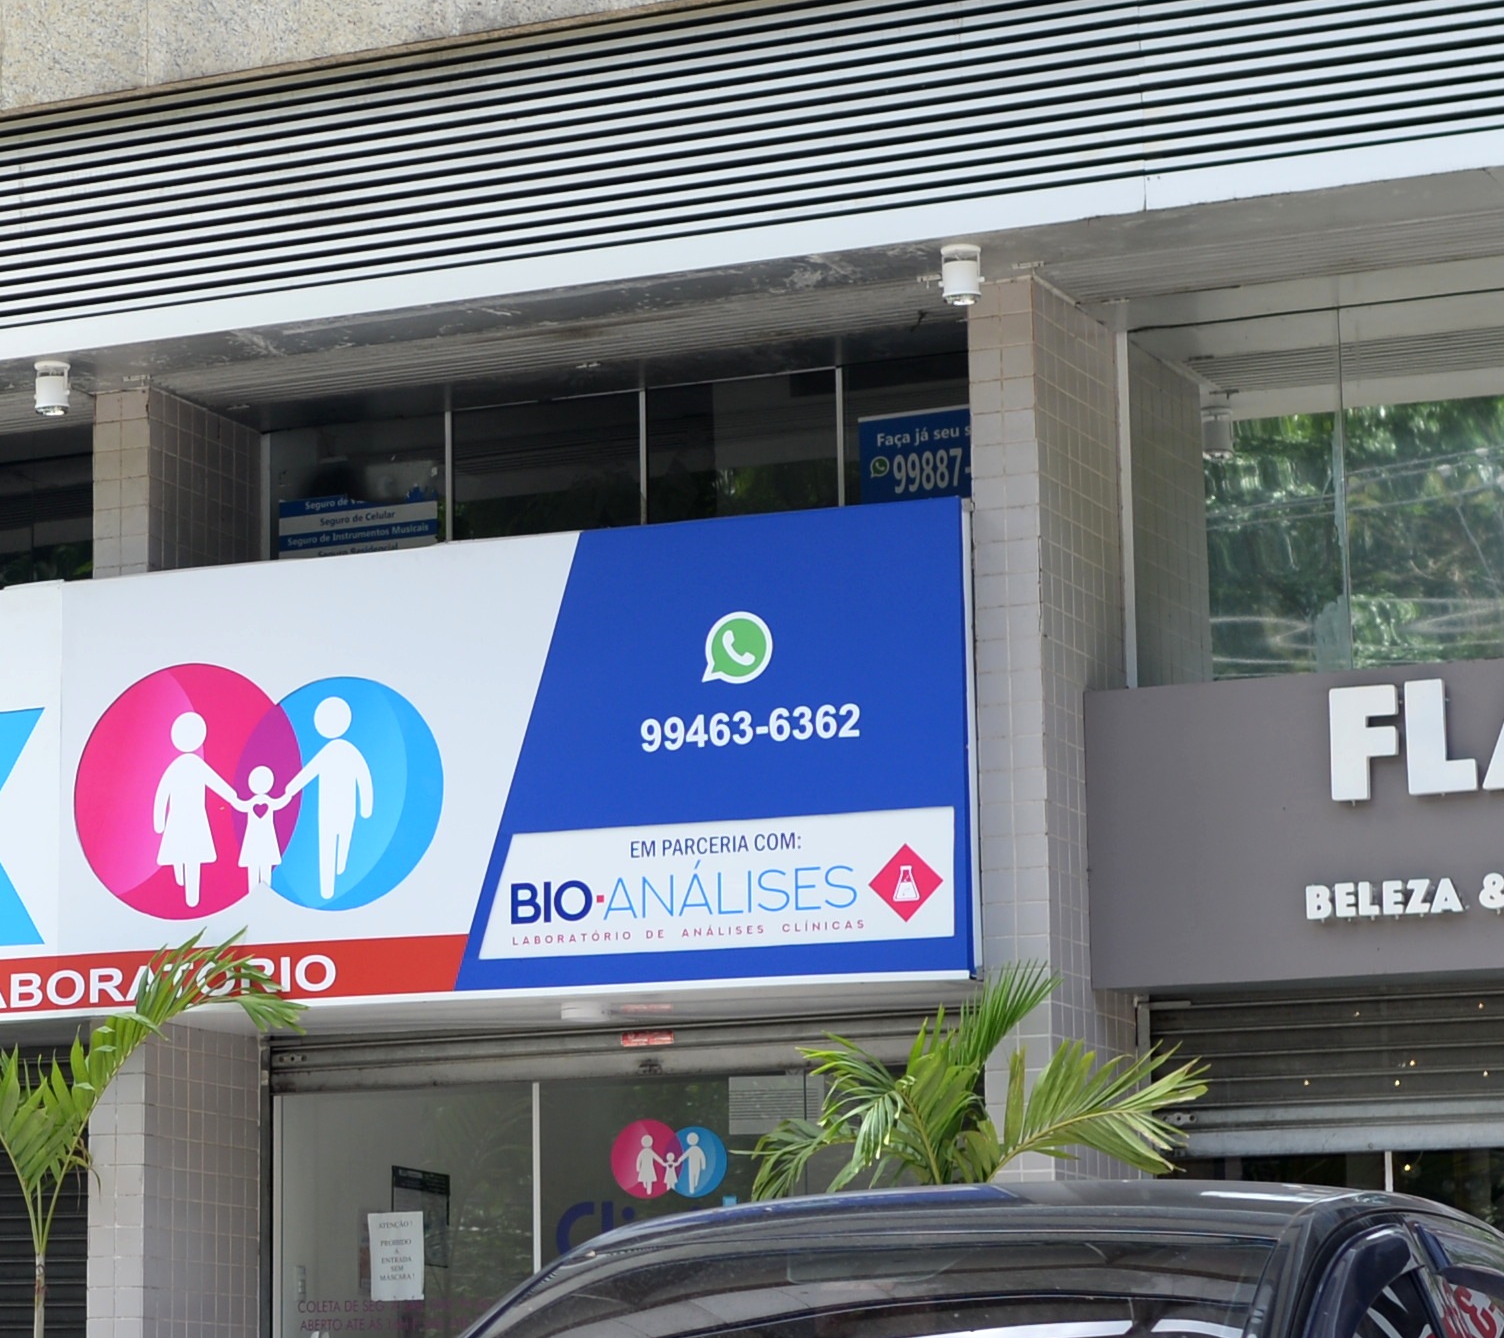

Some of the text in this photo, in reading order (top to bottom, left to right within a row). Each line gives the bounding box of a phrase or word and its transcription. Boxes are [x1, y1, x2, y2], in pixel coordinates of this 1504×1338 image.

[876, 426, 960, 448] Faça já seu
[304, 500, 336, 511] Seguro
[337, 498, 348, 506] de
[319, 511, 396, 527] Seguro de Celular
[287, 523, 429, 547] Seguro de Instrumentos Musicais
[639, 702, 861, 754] 99463-6362
[629, 832, 803, 859] EM PARCERIA COM:
[1305, 876, 1464, 922] BELEZA
[512, 918, 865, 946] LABORATÓRIO DE ANÁLISES CLÍNICAS
[378, 1220, 409, 1229] ATENÇÃO
[380, 1238, 412, 1247] PROIBIDO
[381, 1256, 412, 1264] ENTRADA
[297, 1300, 340, 1313] COLETA
[344, 1300, 359, 1312] DE
[300, 1318, 343, 1331] ABERTO
